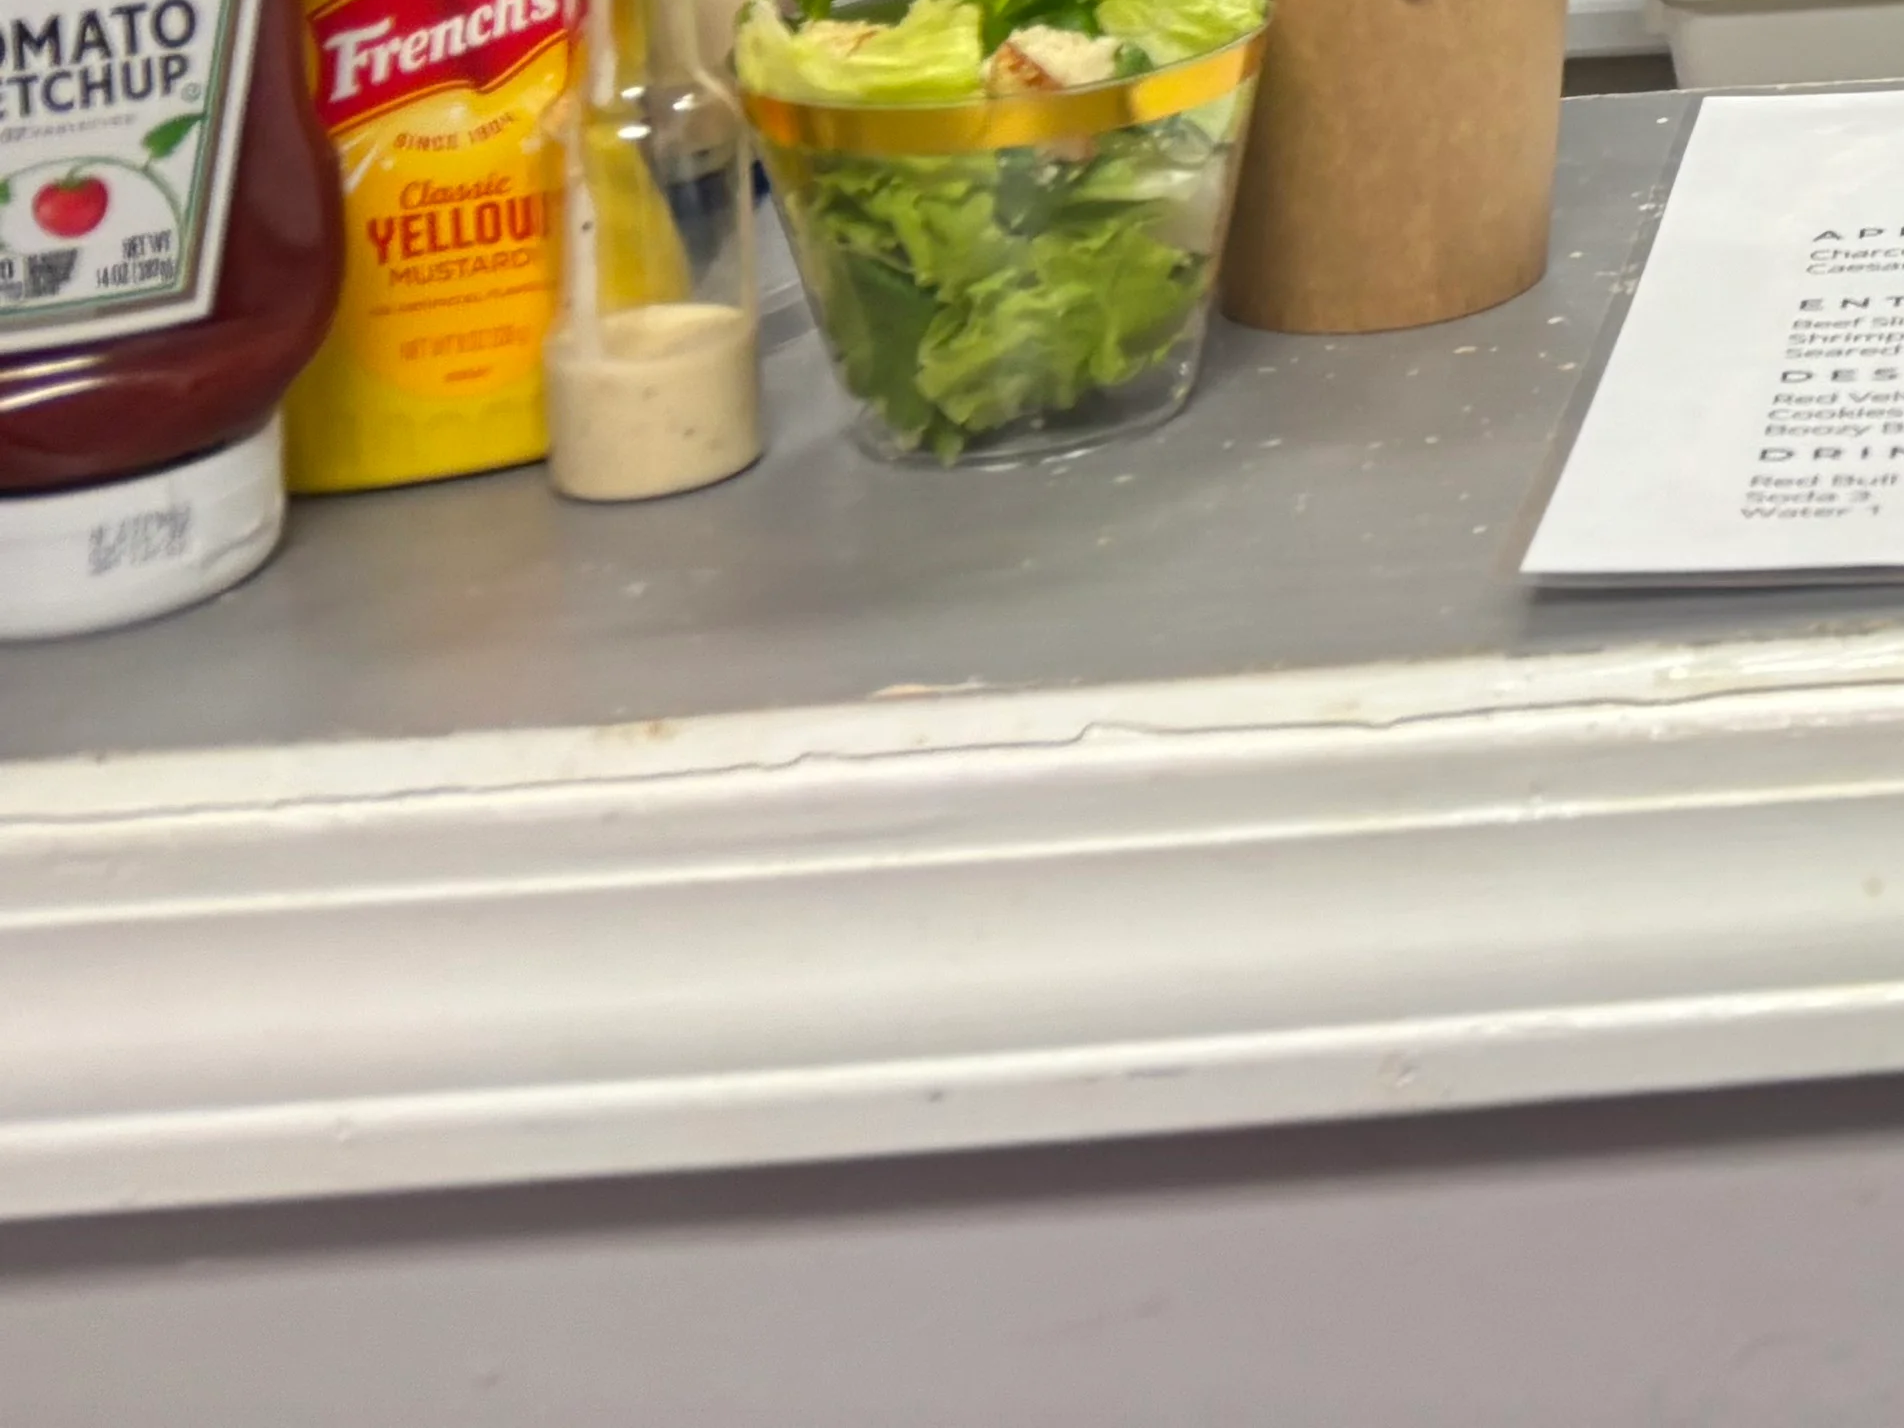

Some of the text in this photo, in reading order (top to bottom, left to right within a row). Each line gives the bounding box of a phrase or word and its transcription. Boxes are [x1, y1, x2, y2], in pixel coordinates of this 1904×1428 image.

[0, 54, 190, 117] TCHUP
[395, 132, 459, 151] SINCE
[400, 169, 512, 209] Classic
[389, 247, 533, 284] MUSTARD
[1792, 315, 1862, 330] Beef
[1785, 344, 1902, 360] Seared
[1772, 391, 1839, 404] Red
[1767, 404, 1904, 422] Cookies
[1763, 423, 1871, 438] Boozy
[1748, 474, 1819, 488] Red
[1831, 472, 1899, 487] Bull
[1745, 489, 1837, 504] Soda
[1740, 506, 1853, 519] Water
